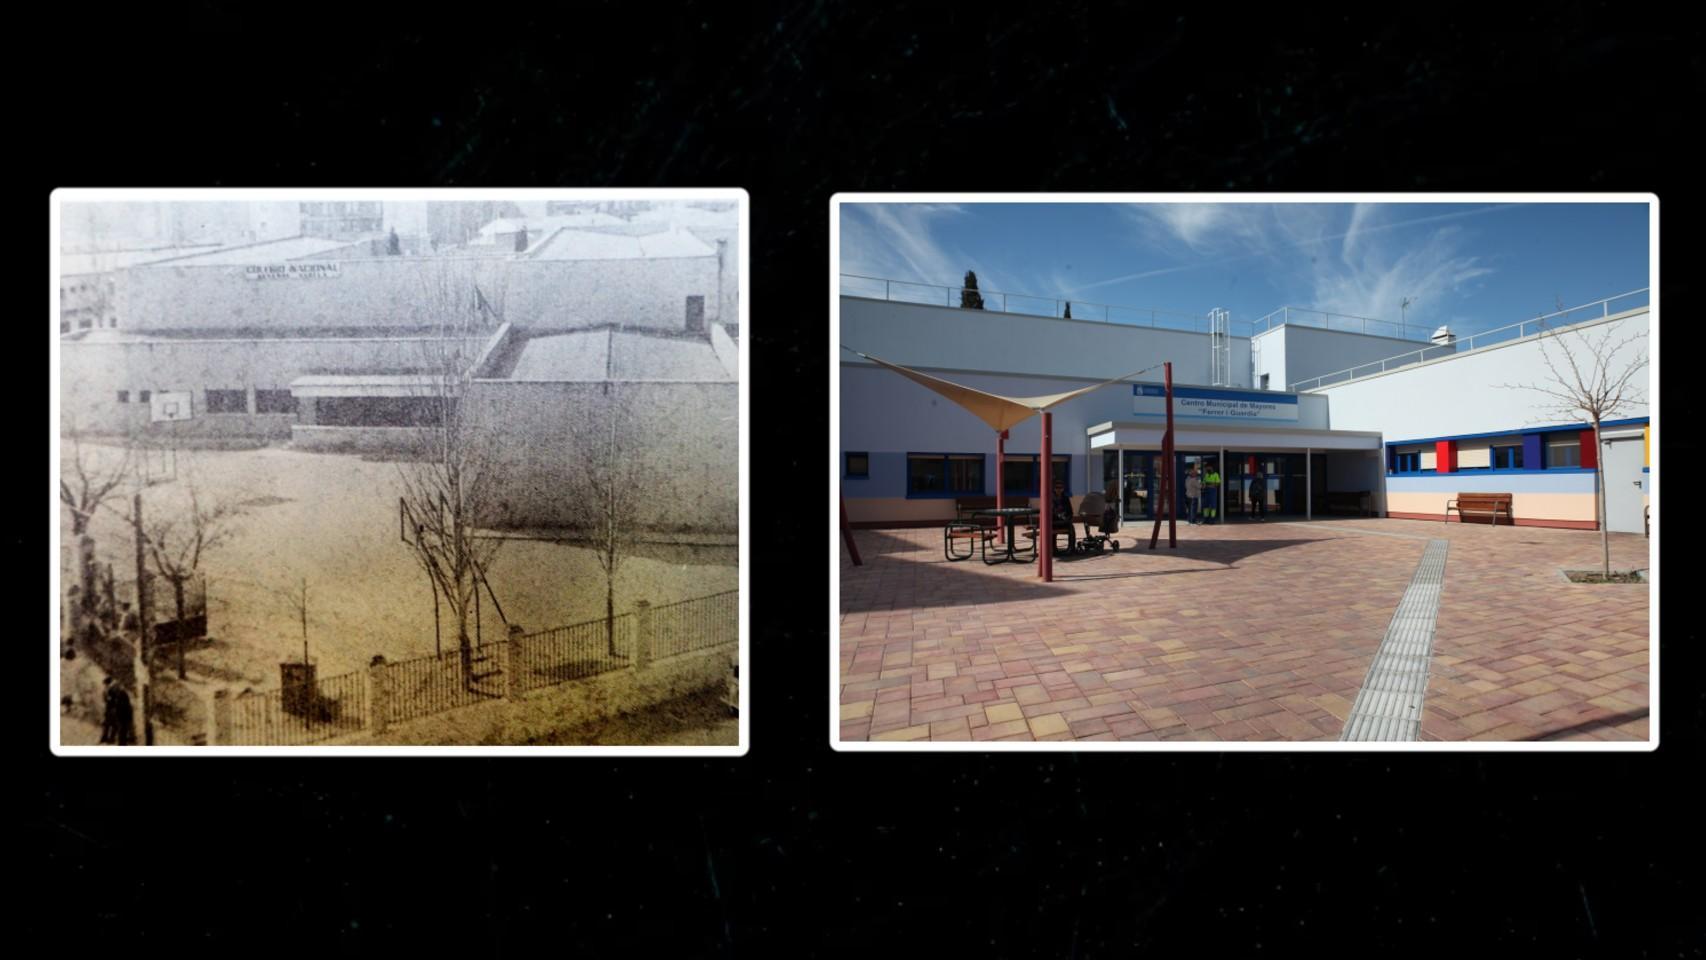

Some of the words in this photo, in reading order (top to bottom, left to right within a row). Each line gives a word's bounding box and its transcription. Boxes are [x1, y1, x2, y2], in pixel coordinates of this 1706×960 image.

[1181, 399, 1205, 407] Centro
[1206, 400, 1239, 409] Municipal
[1240, 401, 1248, 409] de
[1249, 402, 1276, 411] Mayores
